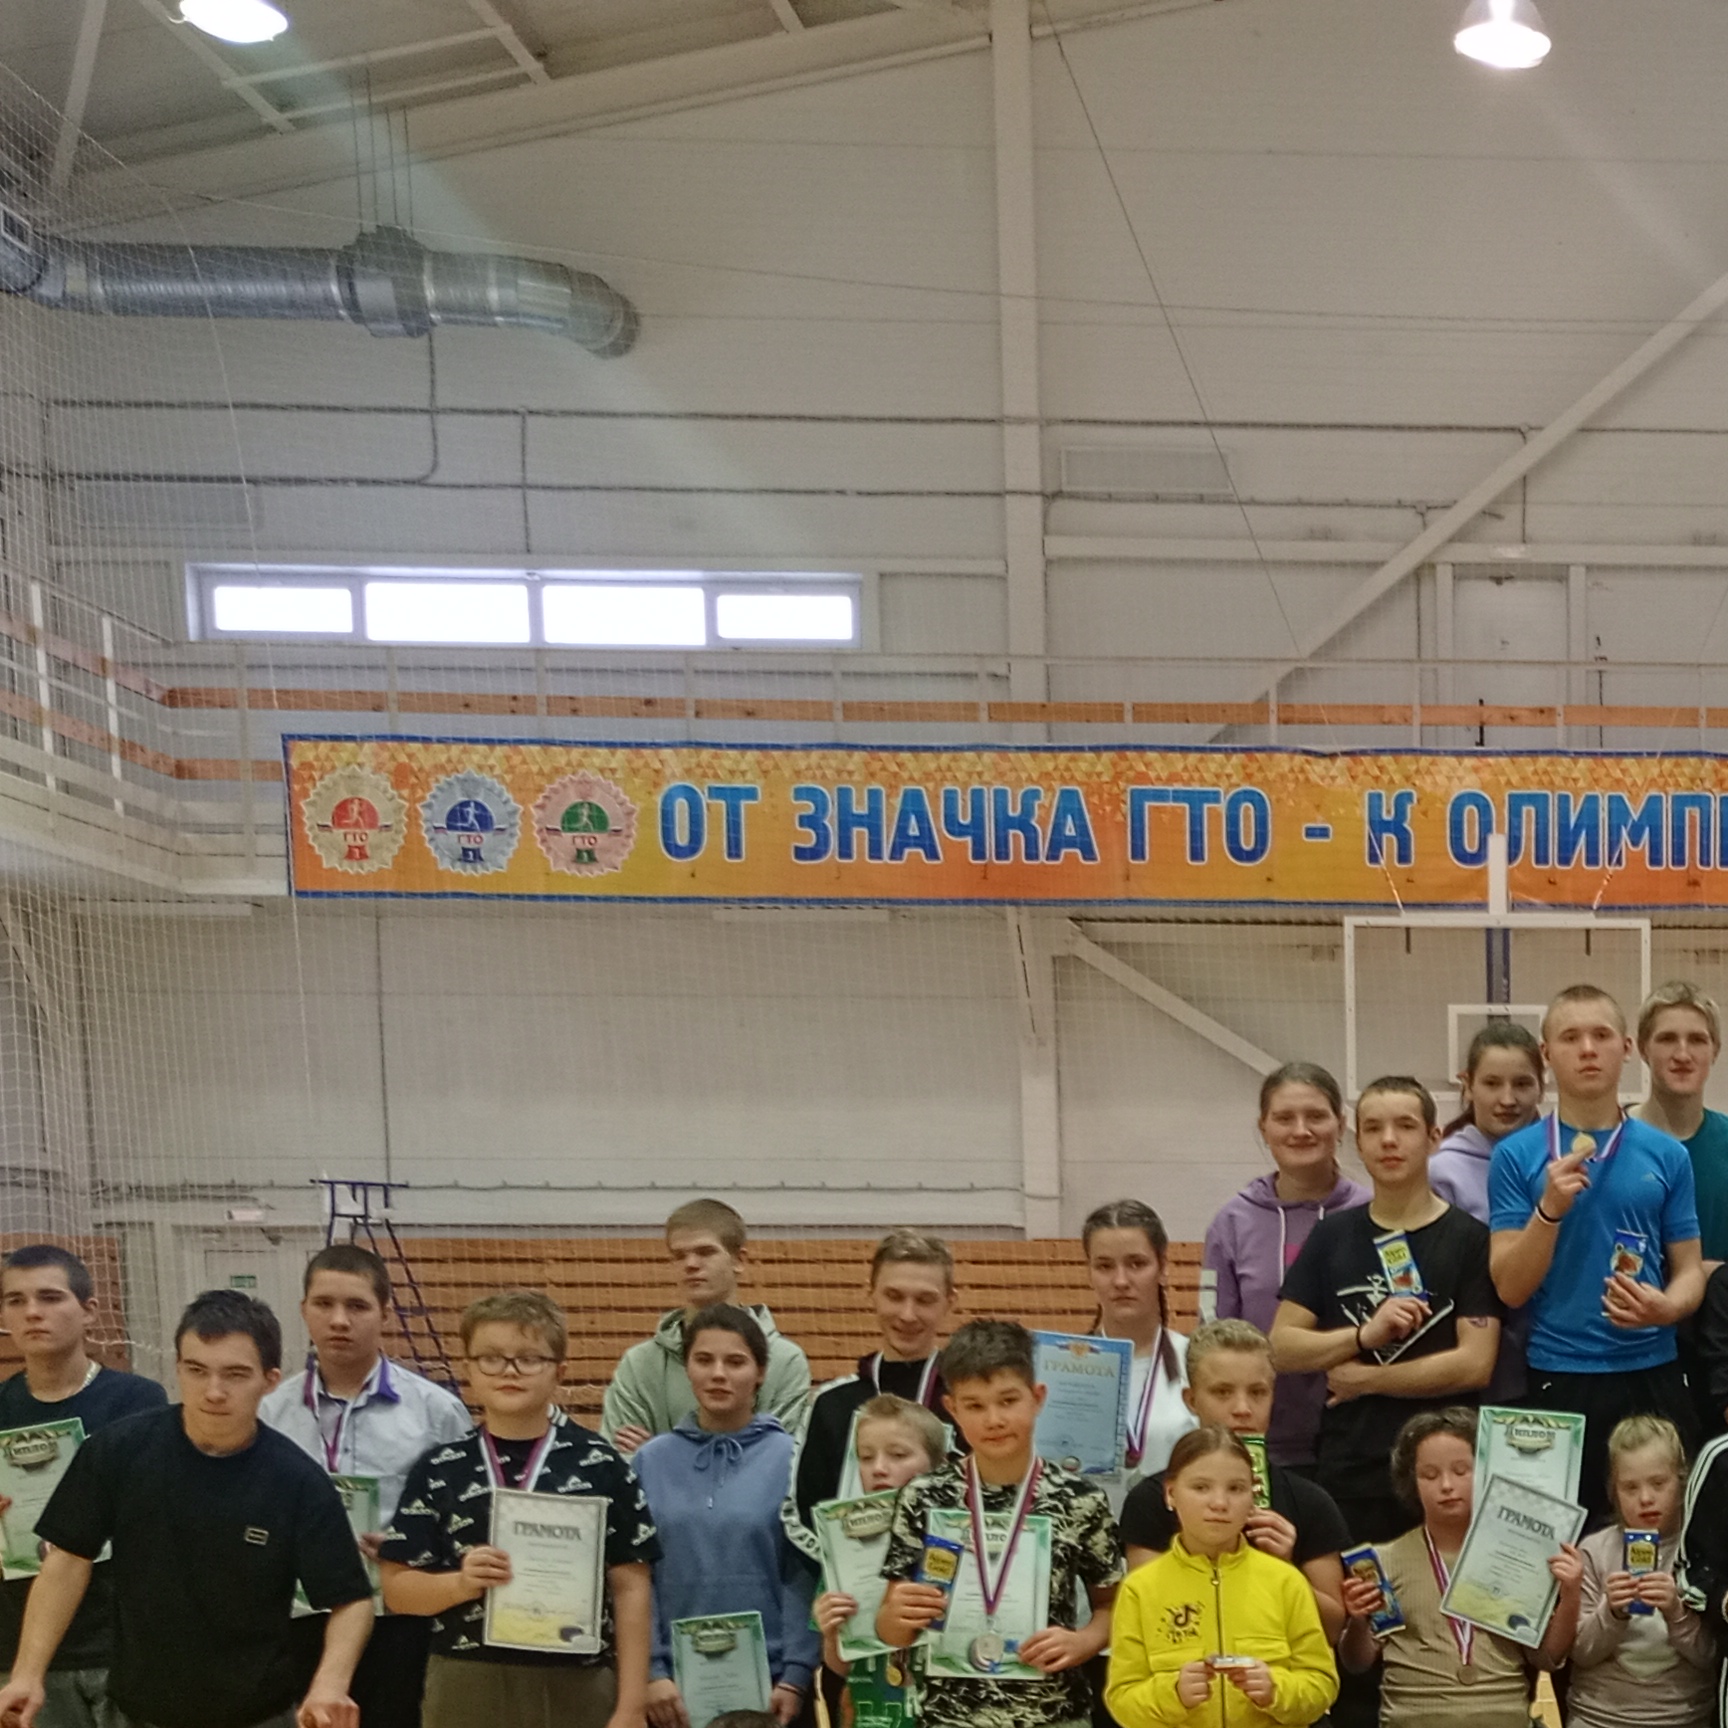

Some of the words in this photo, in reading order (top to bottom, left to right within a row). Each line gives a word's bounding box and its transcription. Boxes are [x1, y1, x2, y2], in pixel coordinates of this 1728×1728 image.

[657, 781, 762, 863] ОТ
[790, 783, 1101, 867] ЗНАЧКА
[1126, 785, 1273, 867] ГТО
[1364, 789, 1418, 868] К
[342, 831, 369, 844] ГТО
[456, 833, 484, 846] ГТО
[572, 836, 599, 849] ГТО
[1044, 1358, 1116, 1378] ГРАМОТА
[513, 1520, 583, 1542] ГРАМОТА
[1497, 1505, 1556, 1541] ГРАМОТА
